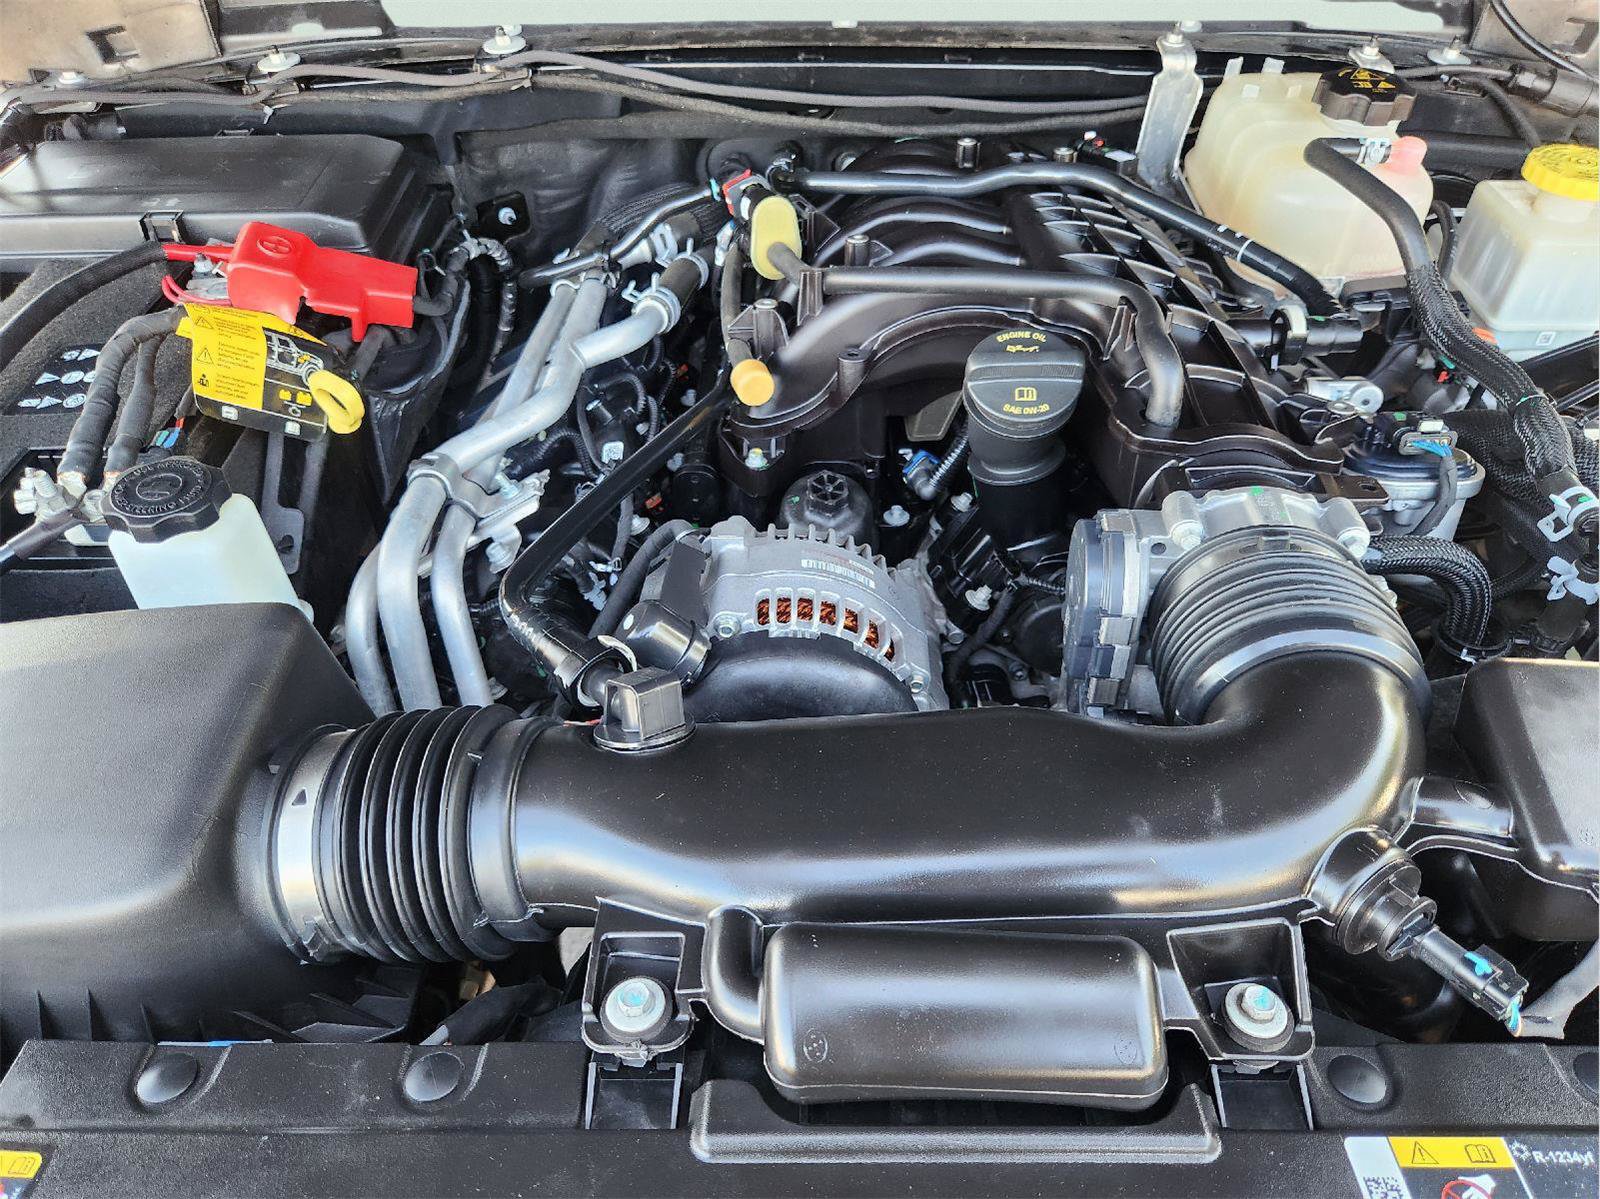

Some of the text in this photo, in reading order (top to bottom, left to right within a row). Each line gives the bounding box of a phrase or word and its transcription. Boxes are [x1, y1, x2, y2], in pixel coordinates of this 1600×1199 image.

[996, 331, 1047, 343] ENGINE OIL
[1003, 403, 1050, 415] SAE 0W-20
[1532, 1150, 1596, 1166] R-1234yf
